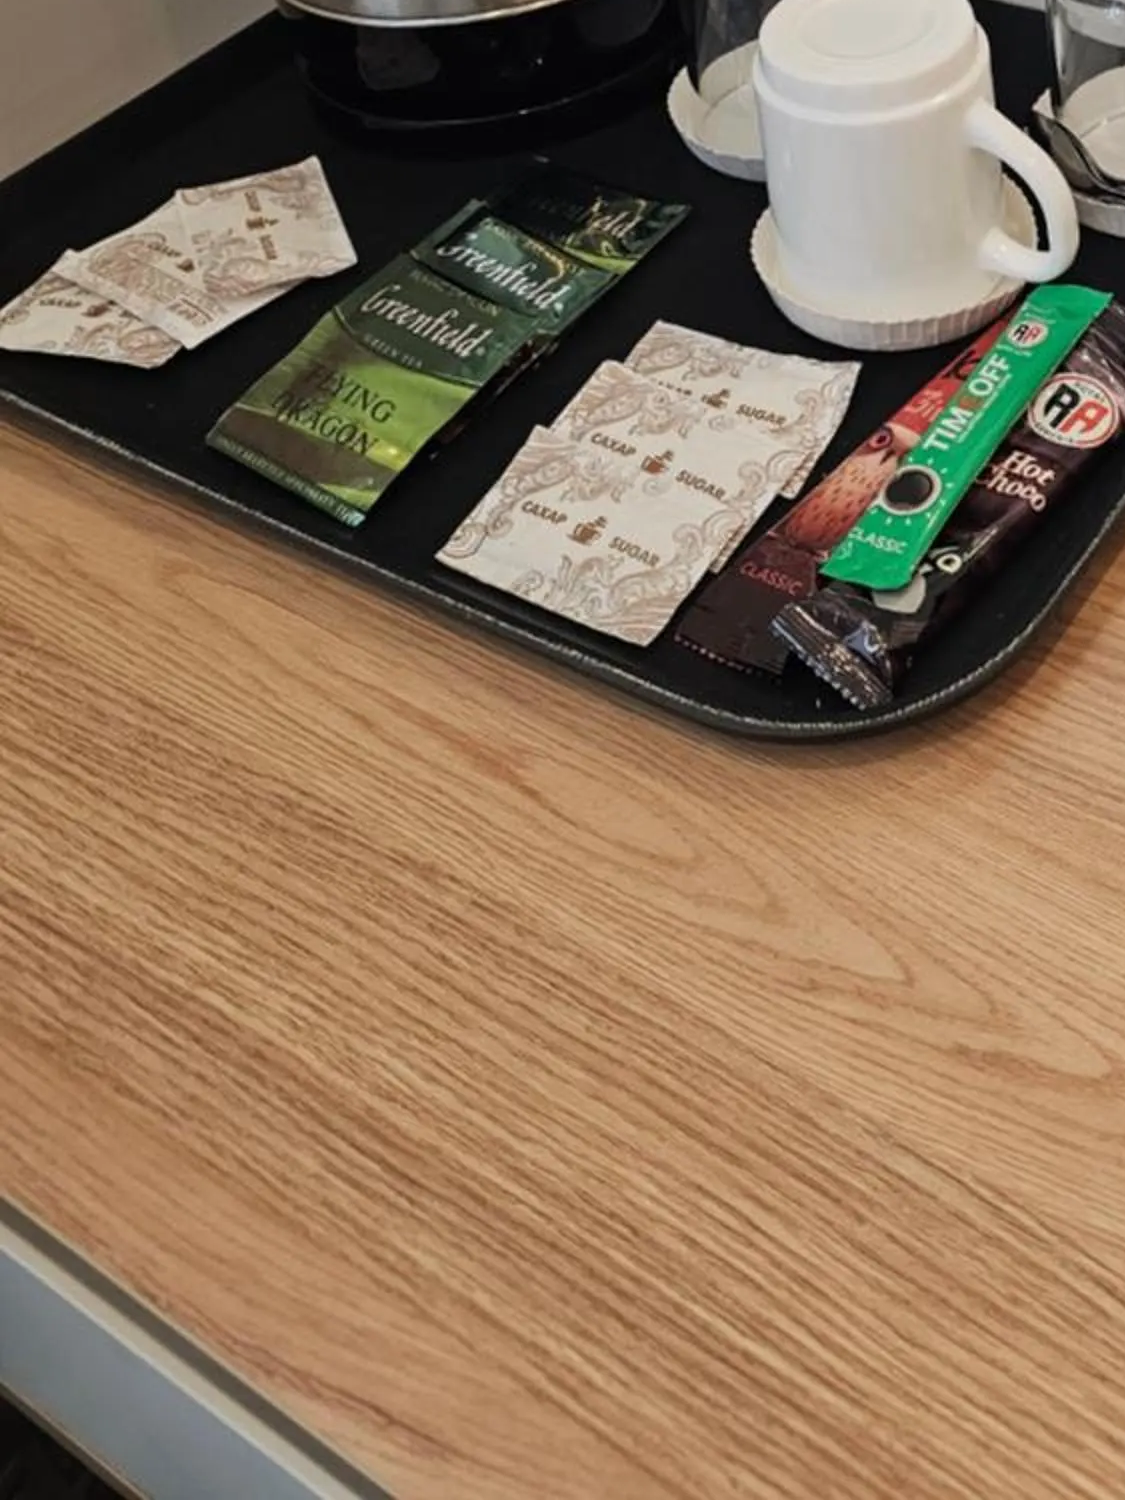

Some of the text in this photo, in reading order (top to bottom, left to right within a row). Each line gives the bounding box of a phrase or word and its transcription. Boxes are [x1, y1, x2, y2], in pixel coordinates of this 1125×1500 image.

[437, 233, 571, 312] Greenfield
[361, 284, 486, 359] Greenfield
[306, 364, 396, 423] FLYING
[968, 353, 1010, 396] OFF
[271, 391, 382, 456] DRAGON
[734, 402, 787, 430] SUGAR
[674, 467, 727, 501] SUGAR
[1000, 450, 1056, 487] Hot
[607, 535, 660, 569] SUGAR
[740, 560, 804, 597] CLASSIC
